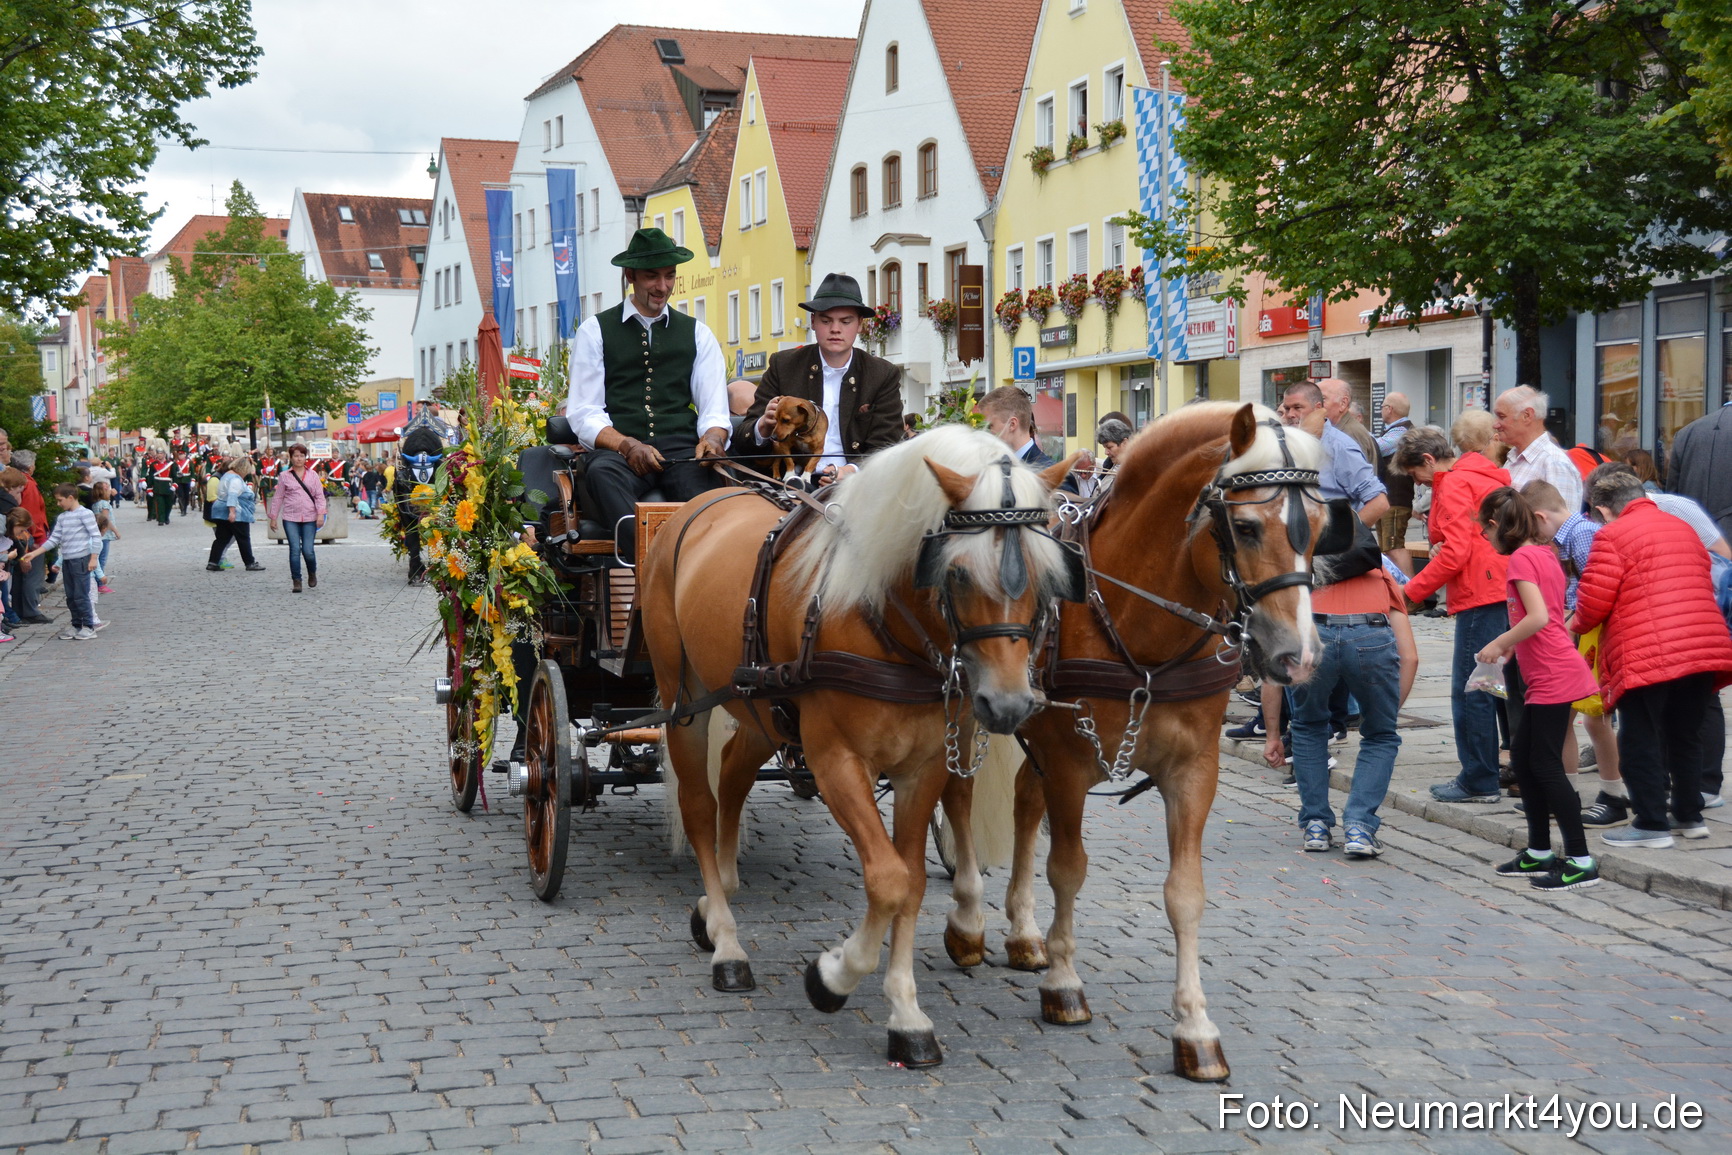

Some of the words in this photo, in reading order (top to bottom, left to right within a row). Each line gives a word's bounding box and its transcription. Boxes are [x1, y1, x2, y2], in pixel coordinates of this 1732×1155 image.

[1296, 309, 1310, 320] DE
[1202, 320, 1216, 333] KINO
[1227, 296, 1235, 354] KINO
[1041, 332, 1055, 343] WOLLE
[1059, 330, 1069, 341] MEH
[743, 354, 761, 368] AIFUN
[1018, 351, 1031, 376] P
[1035, 378, 1047, 390] OLLE
